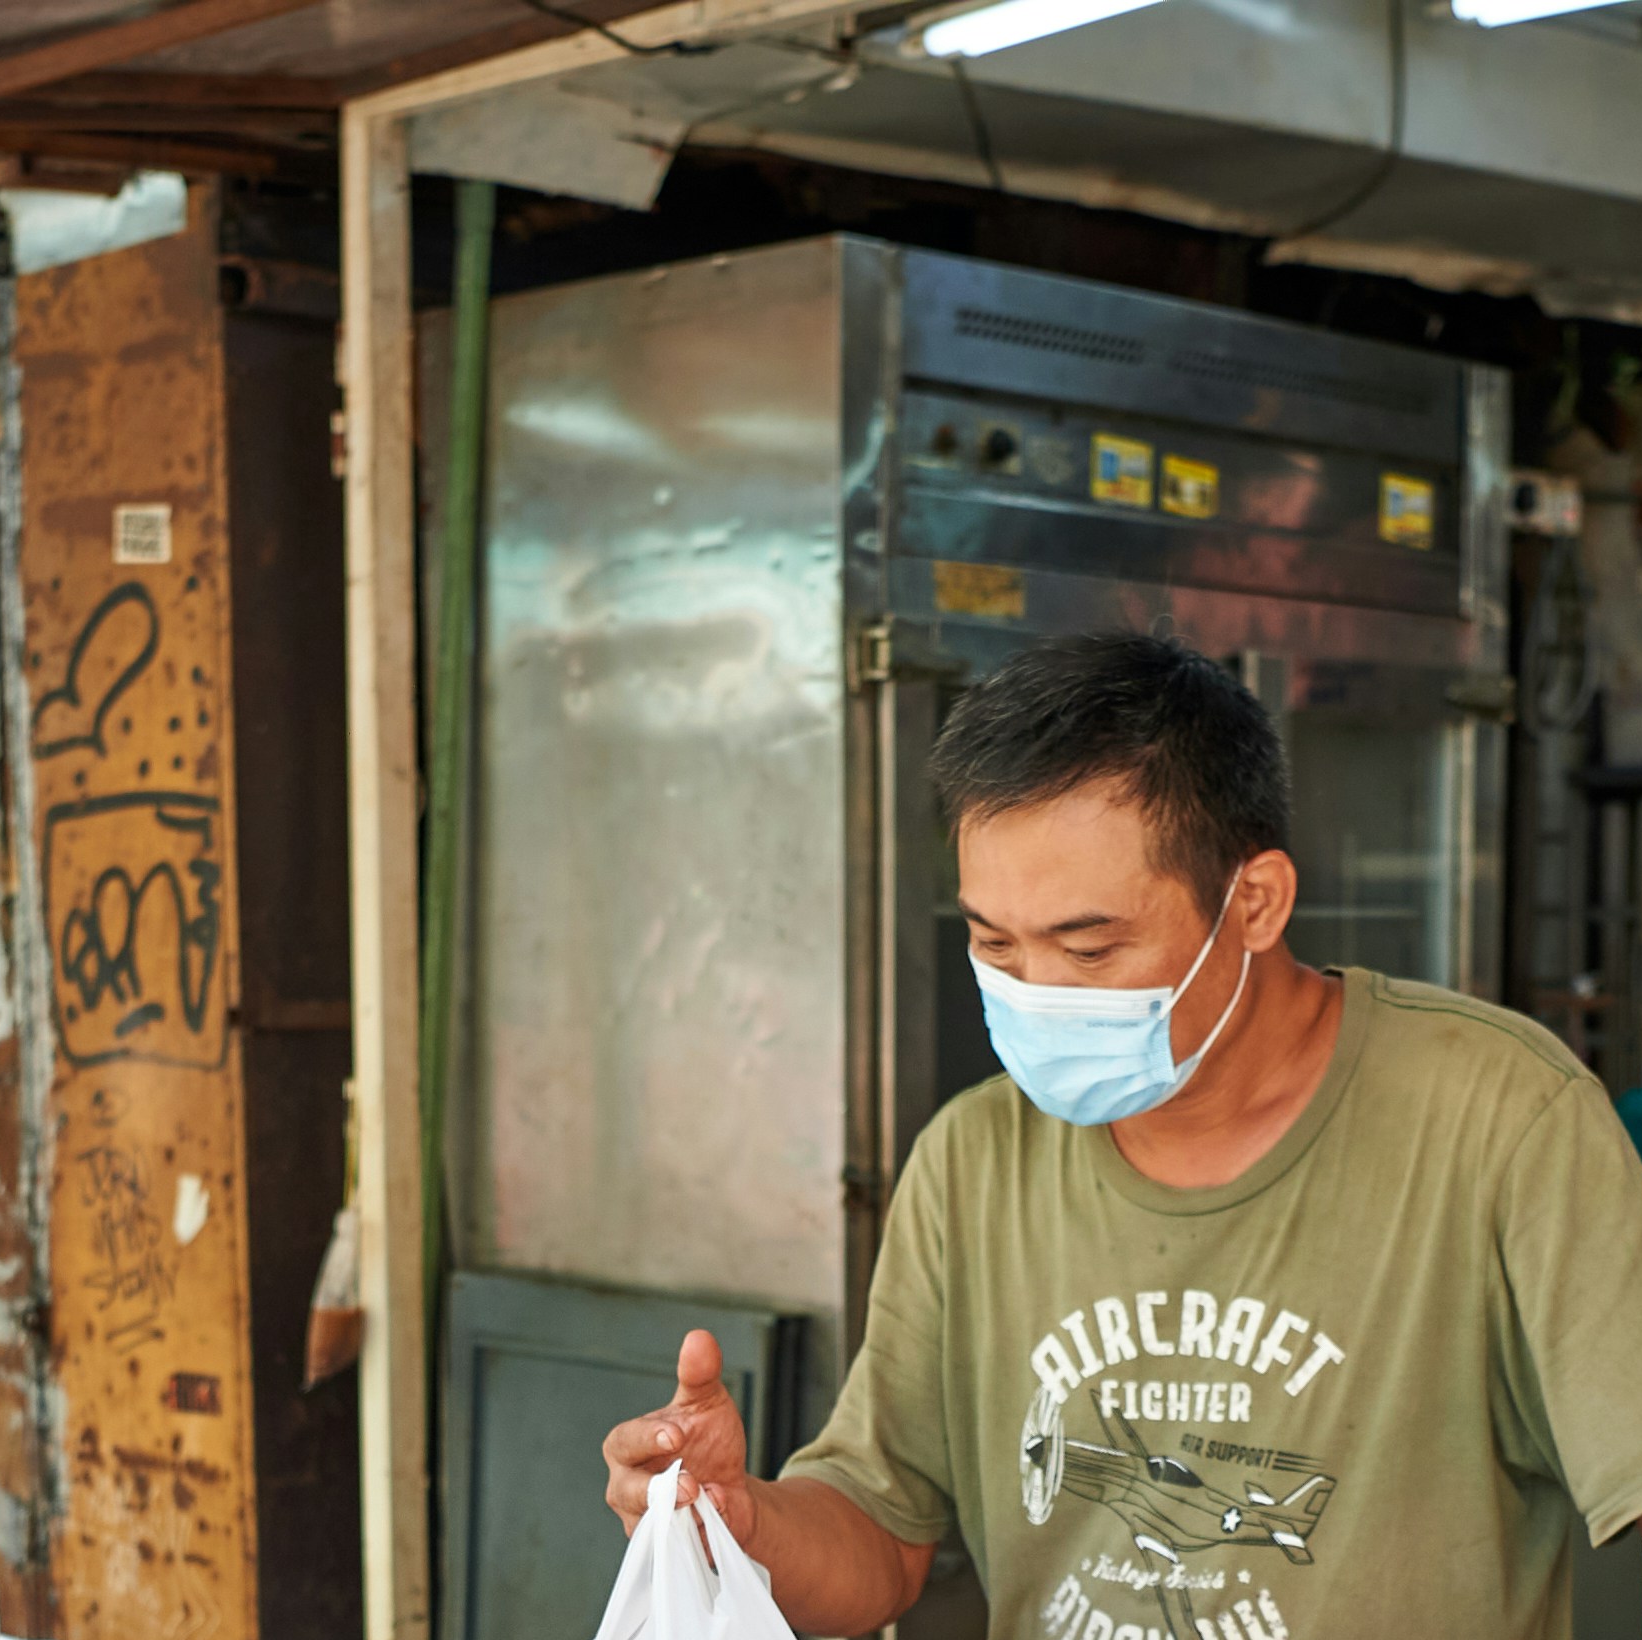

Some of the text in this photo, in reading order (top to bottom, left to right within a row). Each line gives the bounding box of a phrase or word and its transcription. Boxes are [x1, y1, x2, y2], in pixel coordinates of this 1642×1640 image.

[1030, 1289, 1346, 1405] AIRCRAFT
[1100, 1379, 1252, 1423] FIGHTER
[1180, 1433, 1275, 1470] AIR SUPPORT
